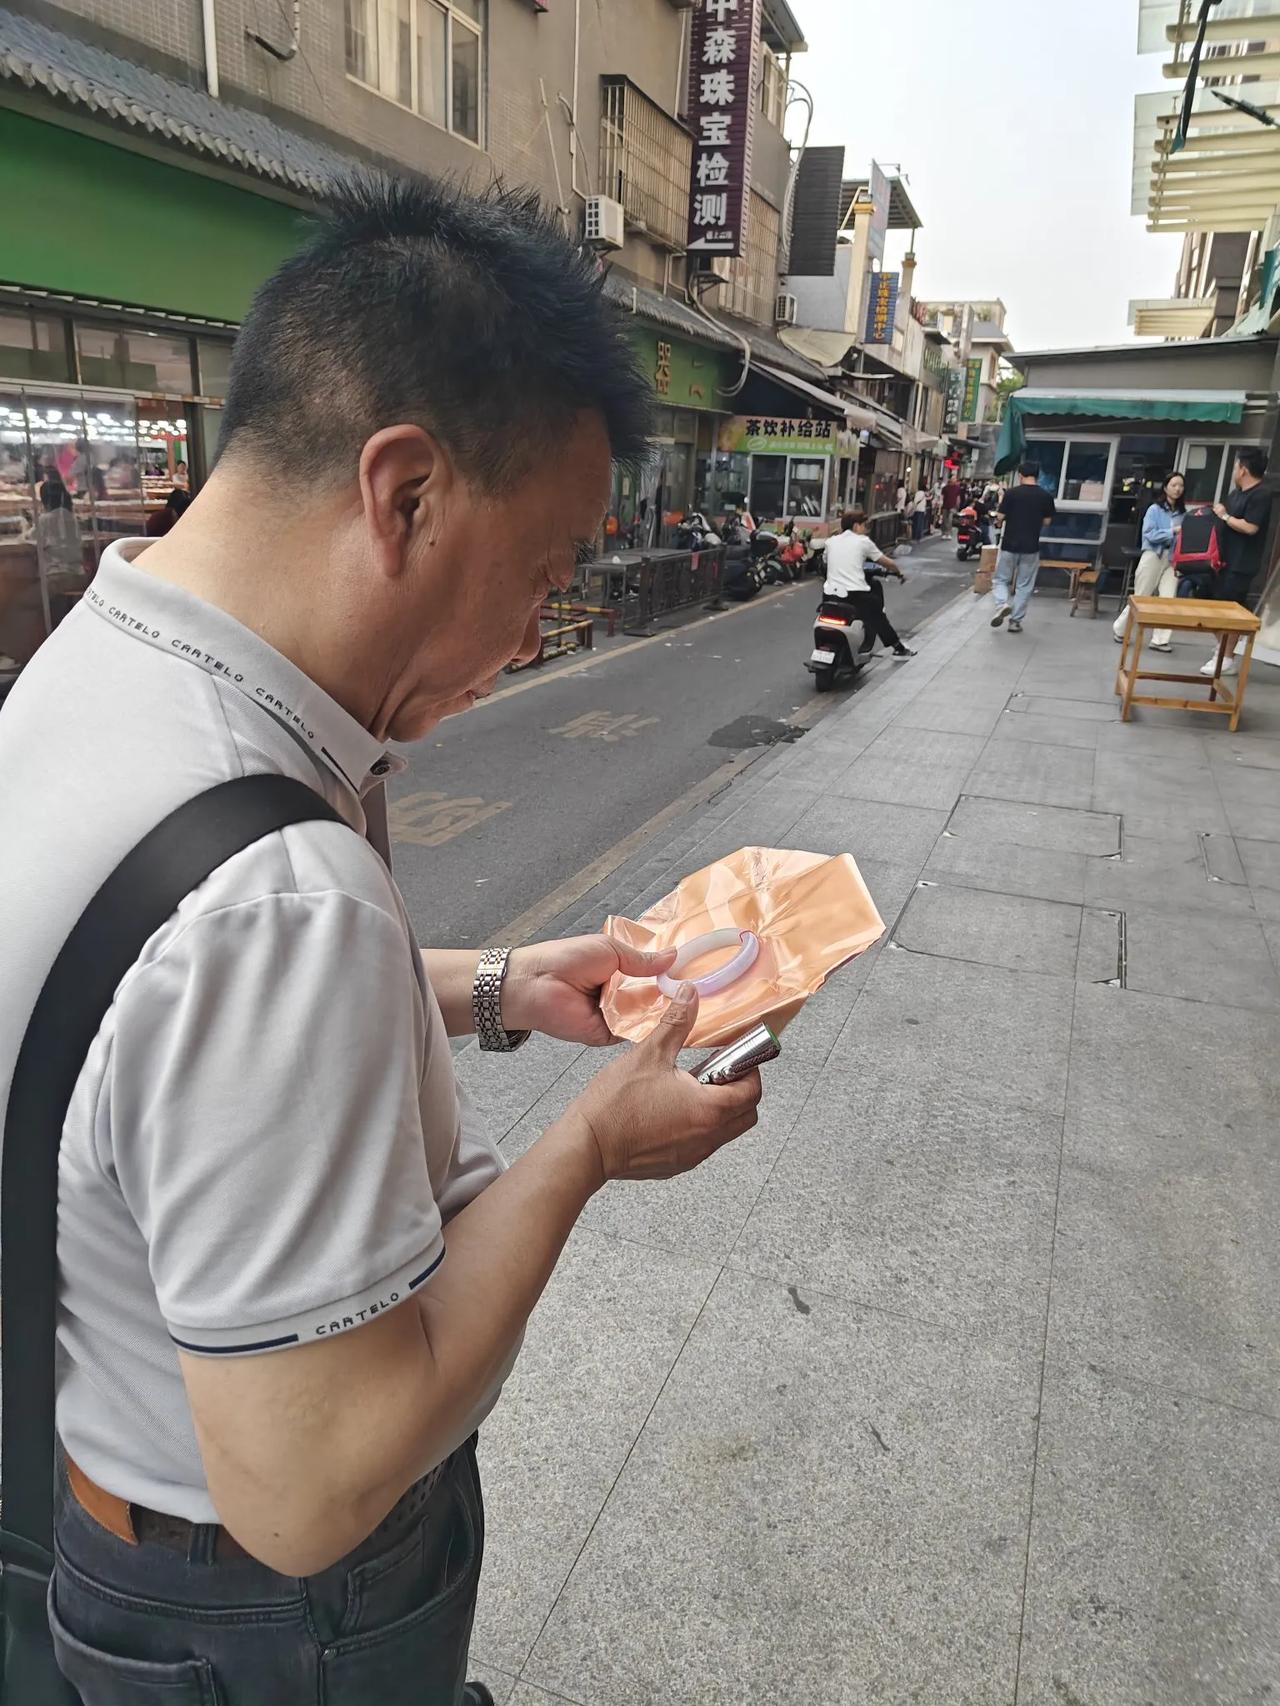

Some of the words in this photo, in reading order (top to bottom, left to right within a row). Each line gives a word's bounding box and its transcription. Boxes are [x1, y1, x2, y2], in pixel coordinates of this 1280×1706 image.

[745, 419, 832, 438] 茶饮补给站
[108, 606, 160, 638] CARTELO
[171, 638, 244, 682] CARTELO
[255, 687, 314, 739] CARTELO
[315, 1292, 399, 1335] CARTELO
